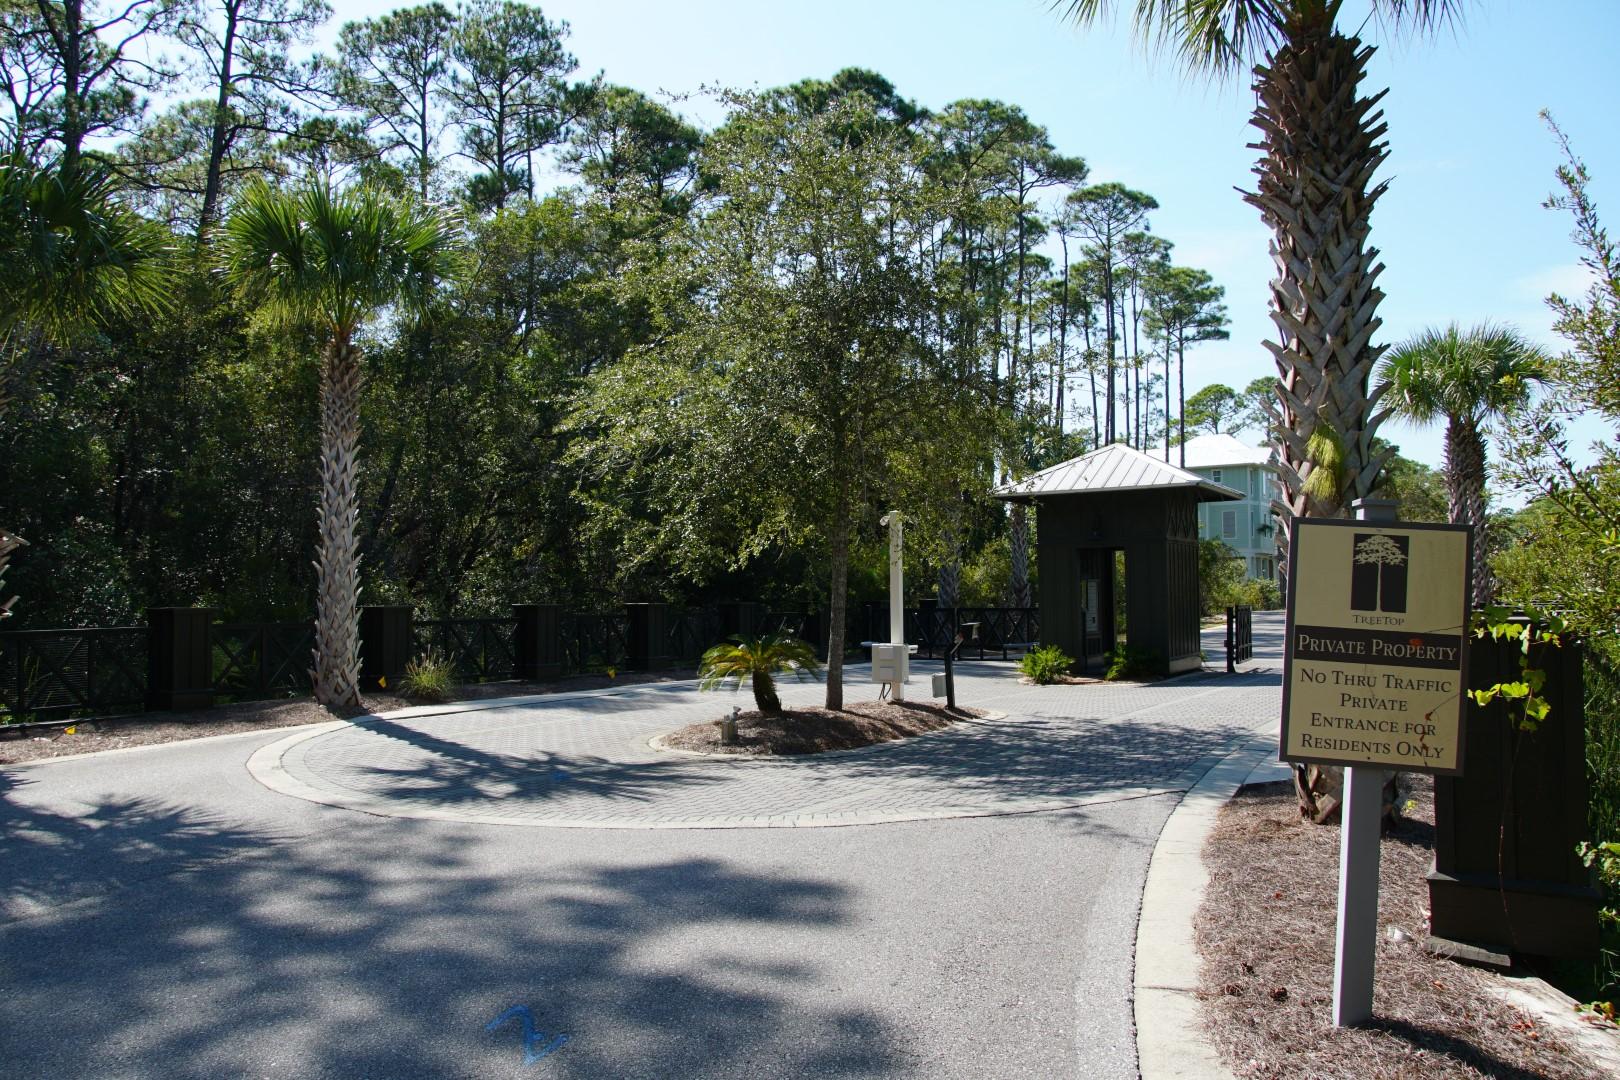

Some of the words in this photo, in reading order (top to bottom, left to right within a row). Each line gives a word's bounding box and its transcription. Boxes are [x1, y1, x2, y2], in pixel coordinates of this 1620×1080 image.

[1352, 614, 1405, 626] TREETOP
[1298, 634, 1366, 655] PRIVATE
[1371, 639, 1458, 660] PROPERTY
[1300, 668, 1327, 684] NO
[1331, 670, 1377, 688] THRU
[1382, 674, 1452, 693] TRAFFIC
[1340, 693, 1408, 712] PRIVATE
[1310, 712, 1398, 733] ENTRANCE
[1404, 722, 1437, 736] FOR
[1301, 733, 1391, 754] RESIDENTS
[1396, 741, 1444, 759] ONLY
